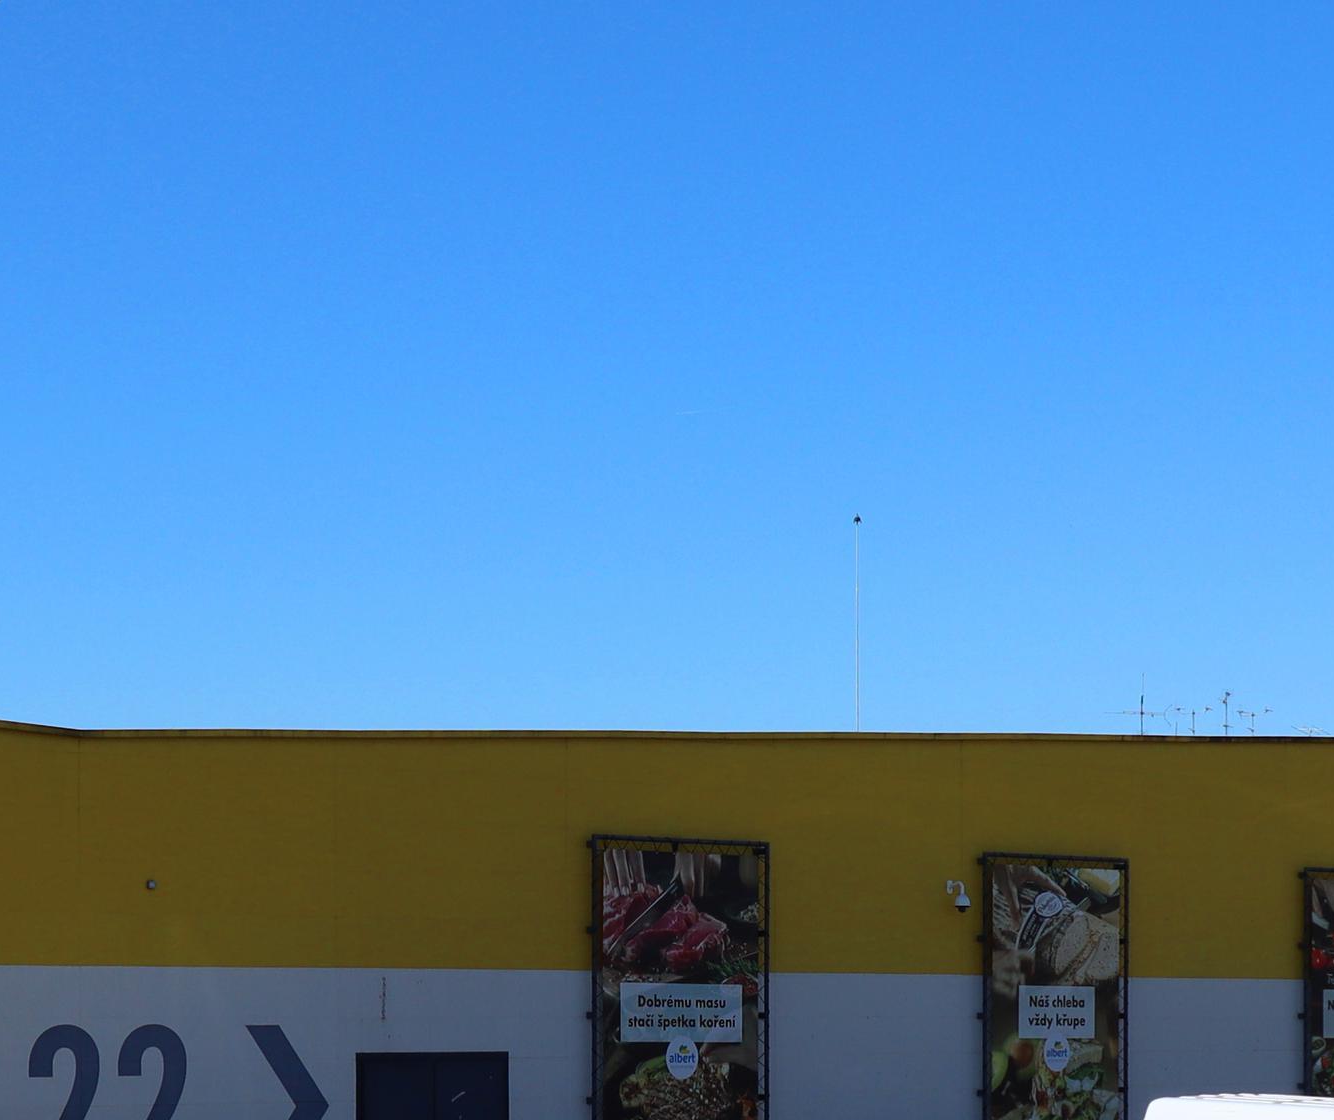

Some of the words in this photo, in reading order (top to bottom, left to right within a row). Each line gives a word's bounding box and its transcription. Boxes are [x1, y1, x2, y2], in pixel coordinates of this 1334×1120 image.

[637, 994, 691, 1008] Dobrému
[695, 999, 726, 1008] masu
[1029, 995, 1050, 1008] Náš
[1052, 995, 1085, 1008] chleba
[628, 1014, 654, 1027] stačí
[657, 1014, 696, 1031] špetka
[699, 1015, 736, 1028] koření
[1028, 1013, 1053, 1030] vždy
[1055, 1013, 1086, 1030] křupe
[669, 1053, 696, 1063] albert
[1046, 1048, 1068, 1058] albert
